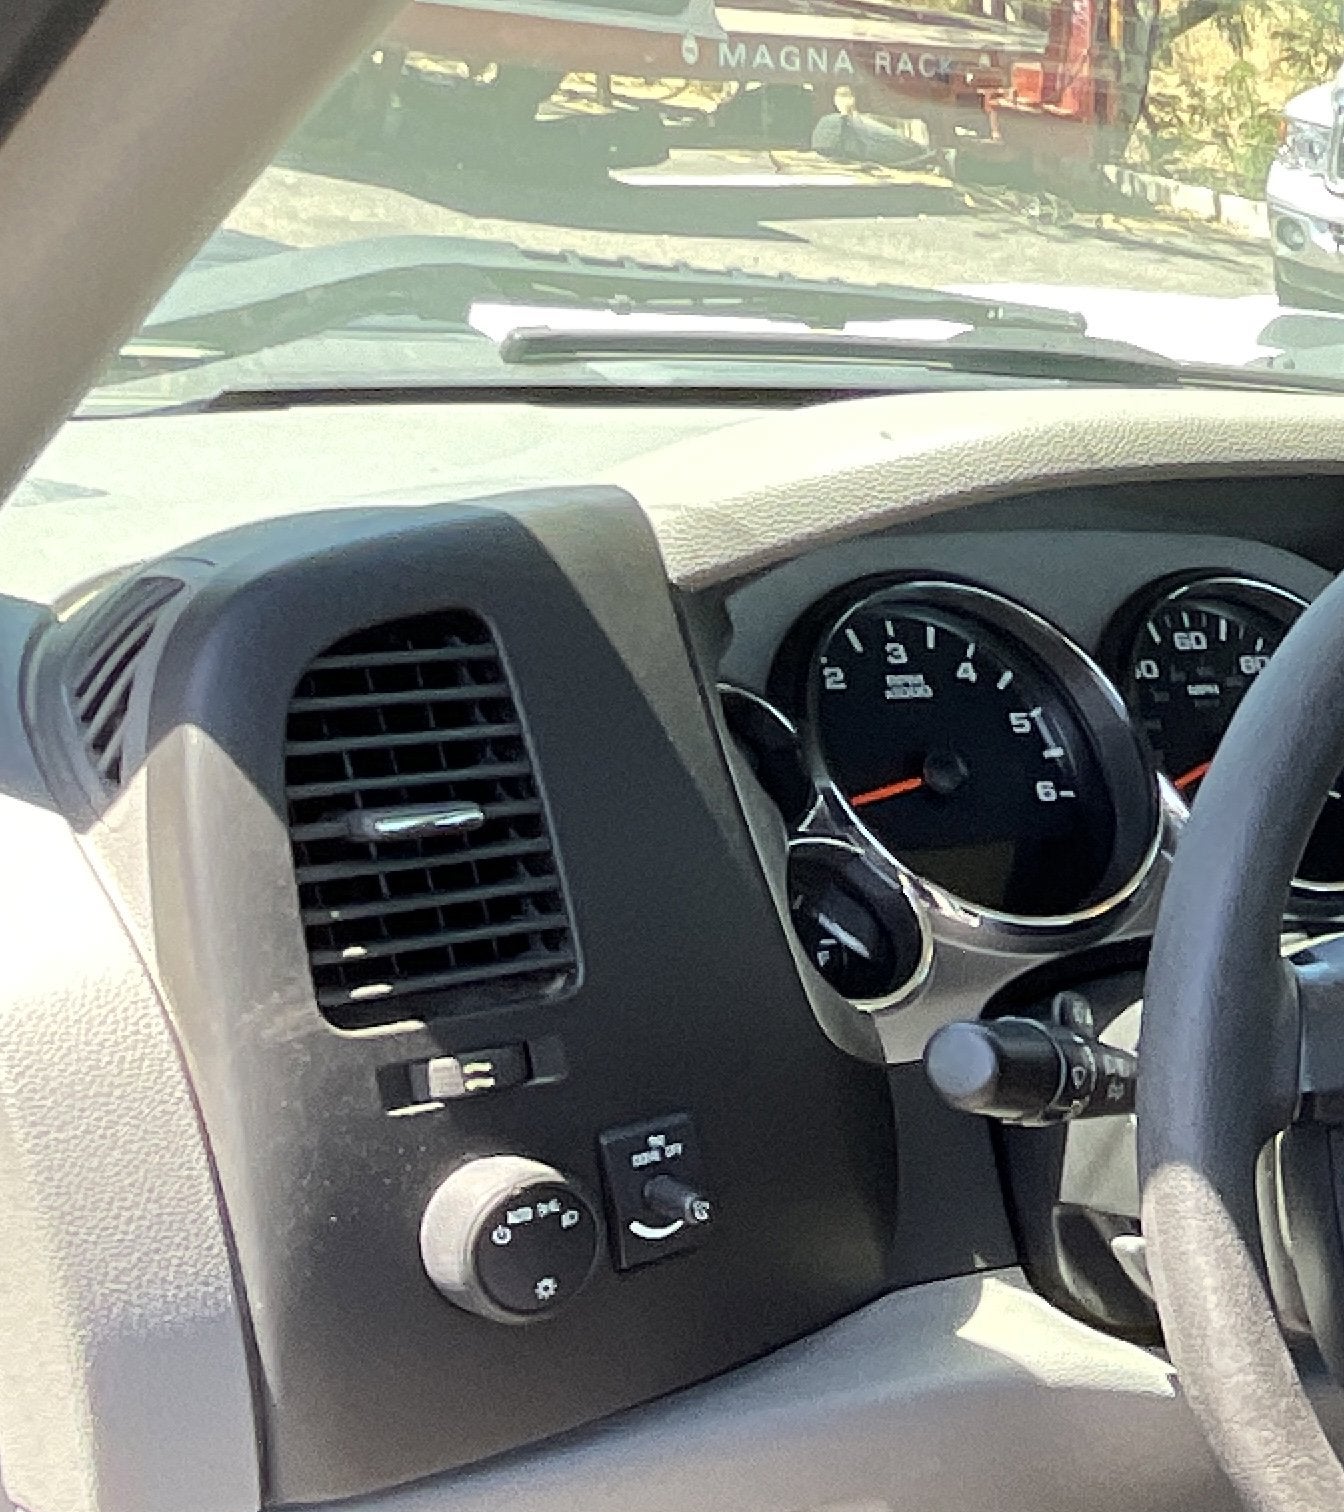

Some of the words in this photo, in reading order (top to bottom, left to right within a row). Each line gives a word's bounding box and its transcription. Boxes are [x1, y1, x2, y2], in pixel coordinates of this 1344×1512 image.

[717, 42, 854, 75] MAGNA
[874, 49, 953, 78] RACK
[1173, 631, 1207, 650] 60
[886, 643, 908, 663] 3
[823, 667, 847, 689] 2
[956, 662, 977, 684] 4
[1009, 713, 1031, 733] 5
[1036, 781, 1057, 801] 6
